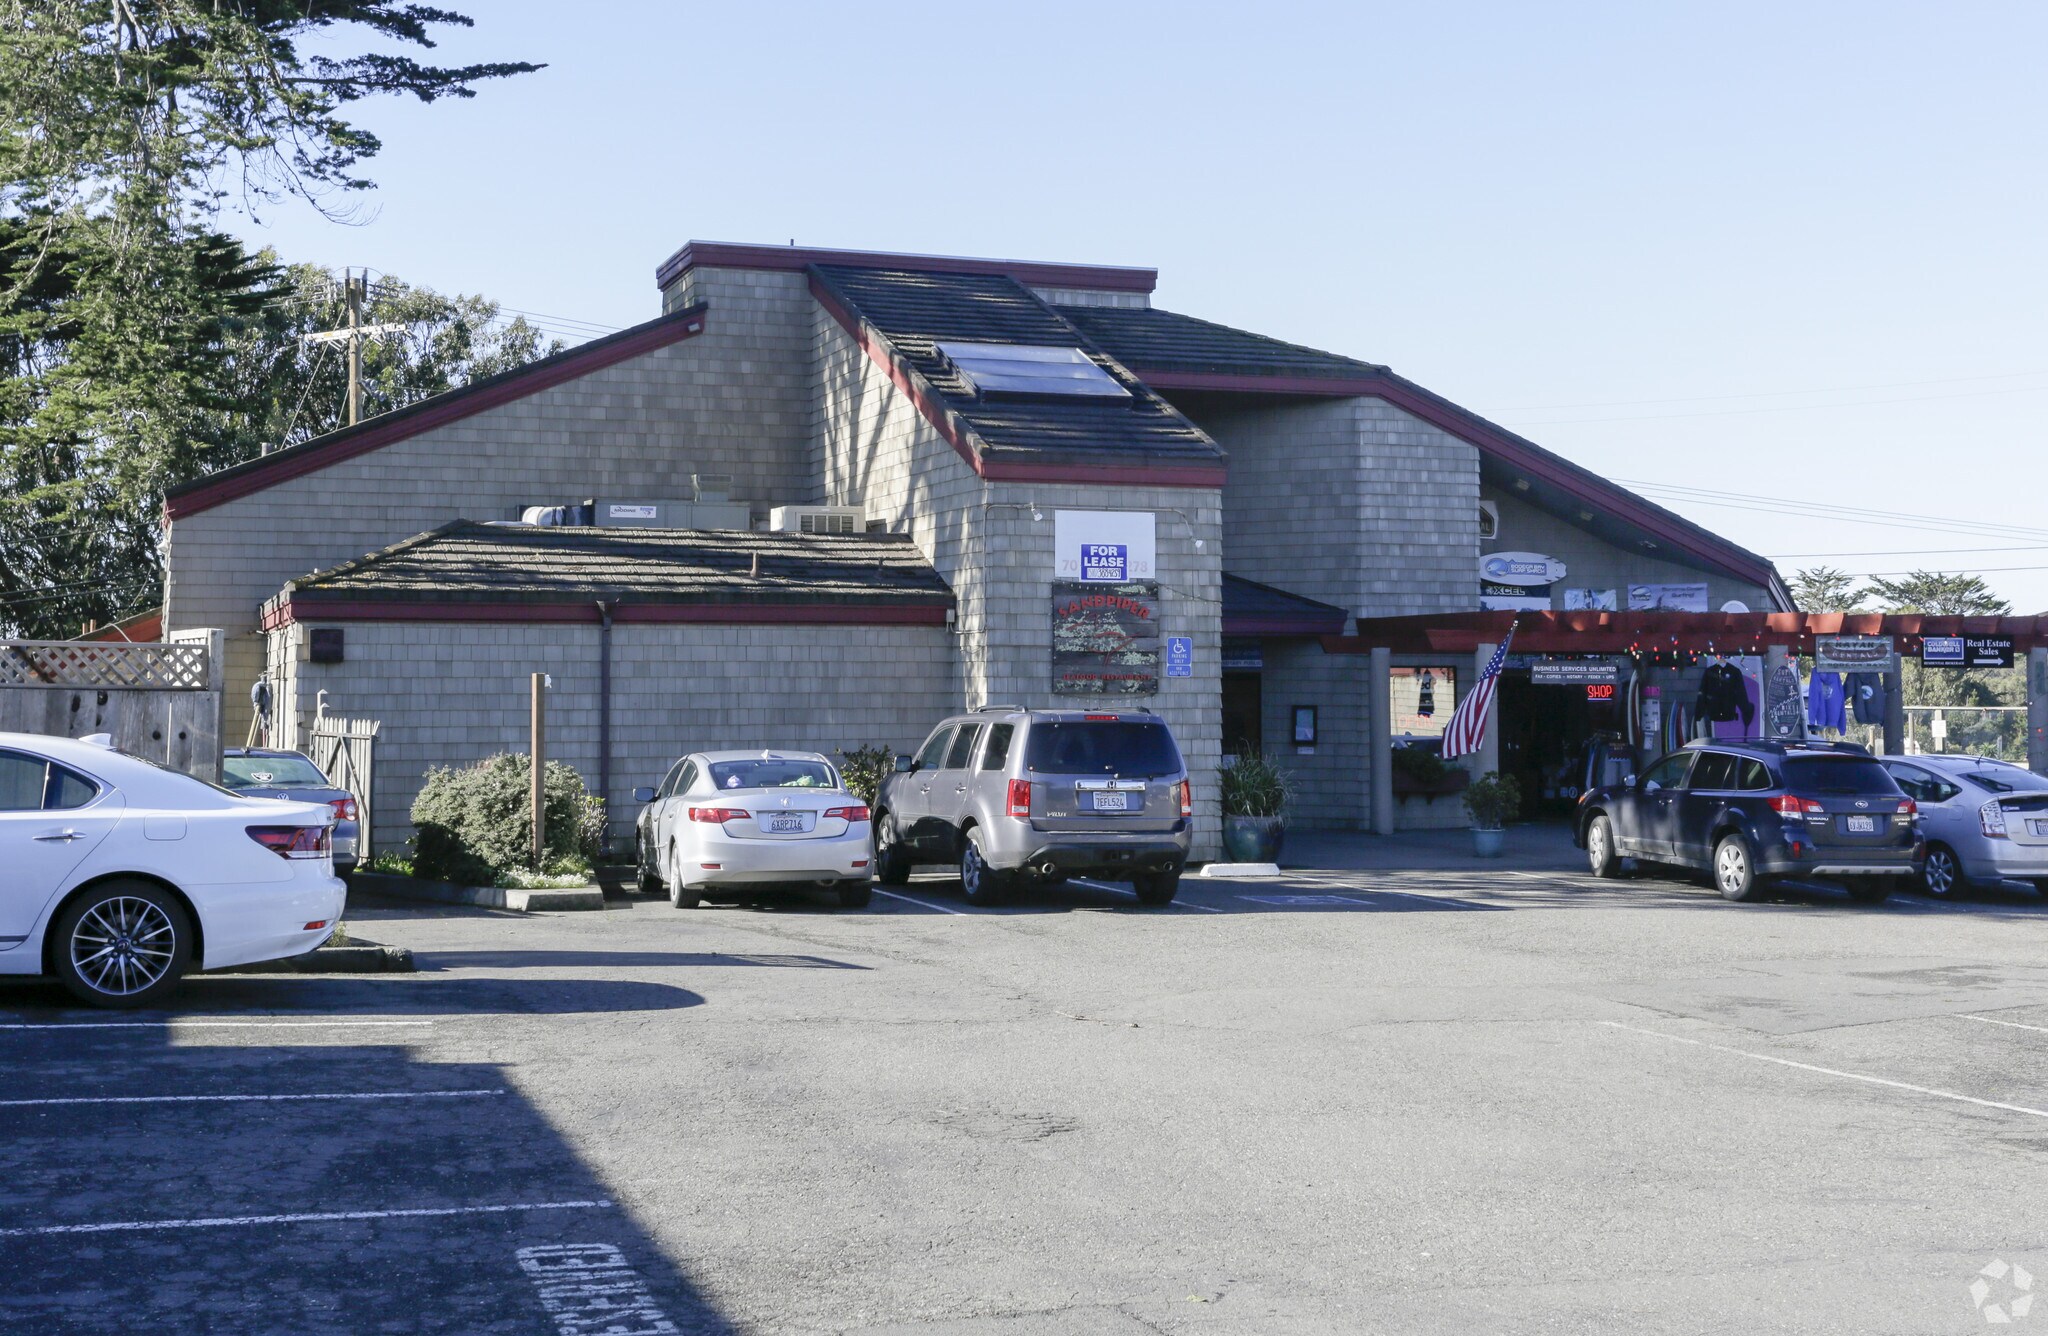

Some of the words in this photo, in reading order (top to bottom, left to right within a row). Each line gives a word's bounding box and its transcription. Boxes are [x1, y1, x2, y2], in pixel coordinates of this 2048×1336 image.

[1090, 546, 1118, 556] FOR
[1084, 557, 1124, 567] LEASE
[1494, 586, 1526, 595] XCEL
[1057, 595, 1150, 620] SANDPIPER
[1967, 639, 1985, 647] Real
[1986, 639, 2011, 648] Estate
[1587, 684, 1613, 697] SHOP
[1096, 798, 1124, 807] 7EFL524
